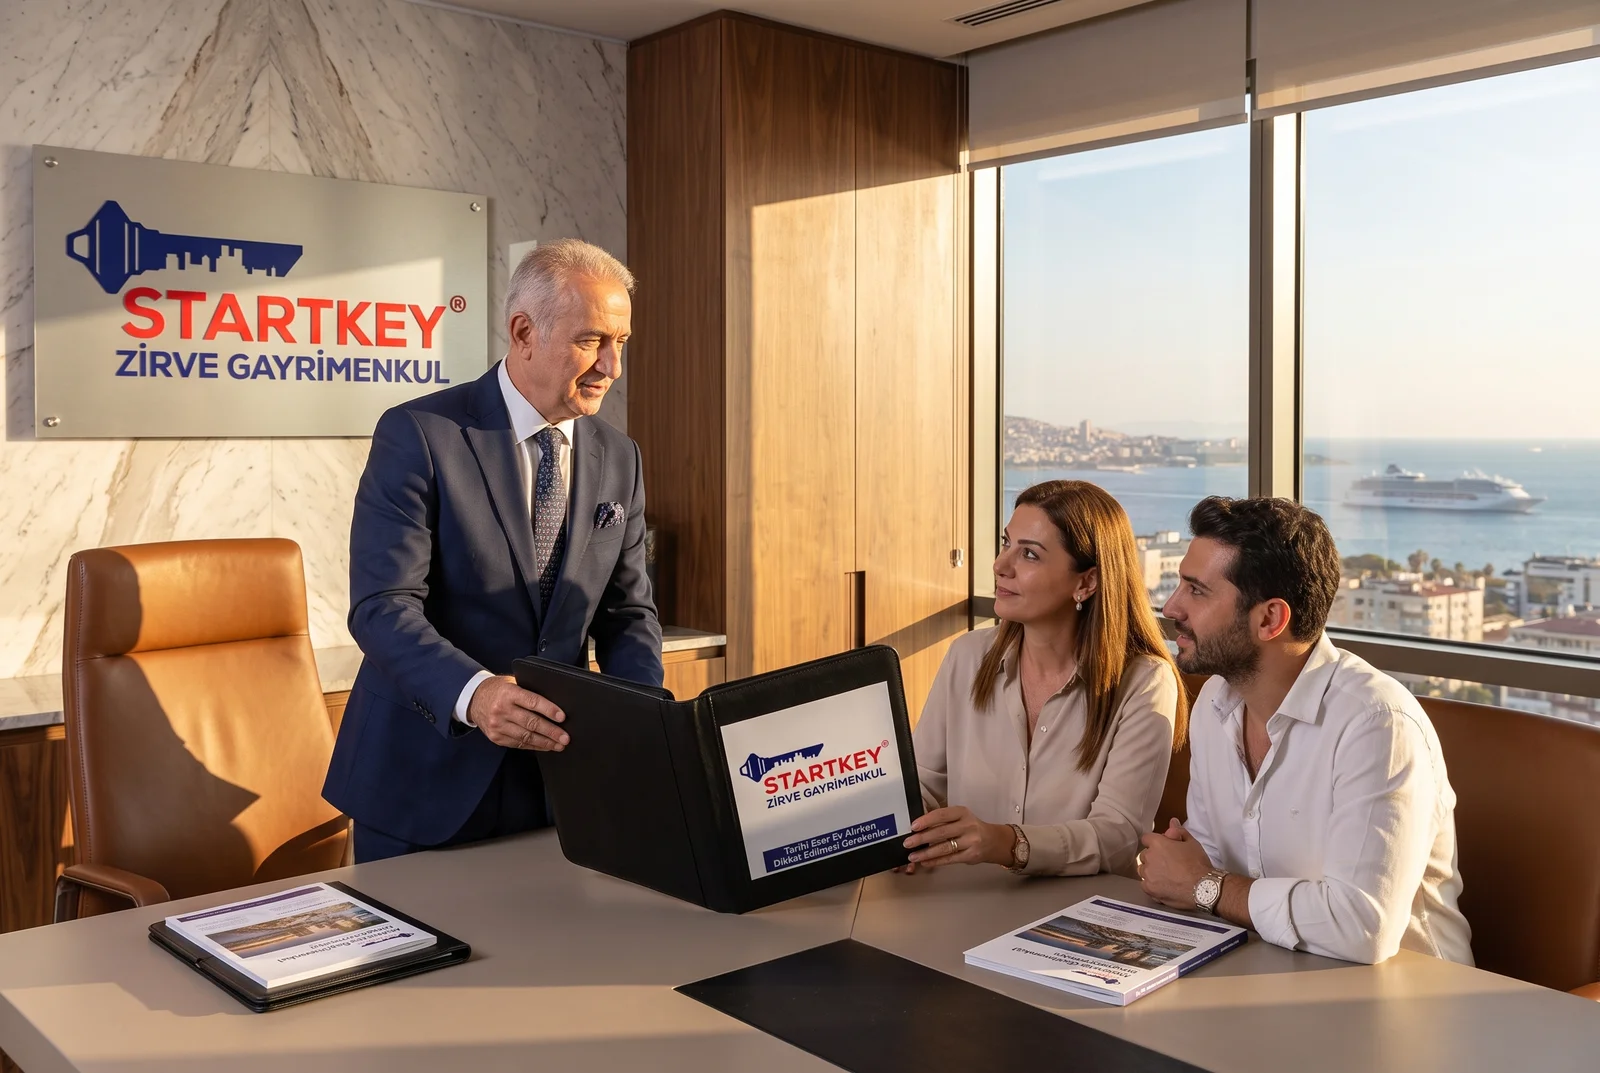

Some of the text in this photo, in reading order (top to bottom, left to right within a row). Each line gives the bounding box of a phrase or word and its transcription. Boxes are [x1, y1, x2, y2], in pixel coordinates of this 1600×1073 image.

[116, 342, 450, 384] ZİRVE GAYRİMENKUL
[766, 768, 887, 809] ZİRVE GAYRİMENKUL
[773, 828, 890, 868] Dikkat Edilmesi Gerekenler
[784, 823, 877, 855] Tarihi Eser Ev Alırken
